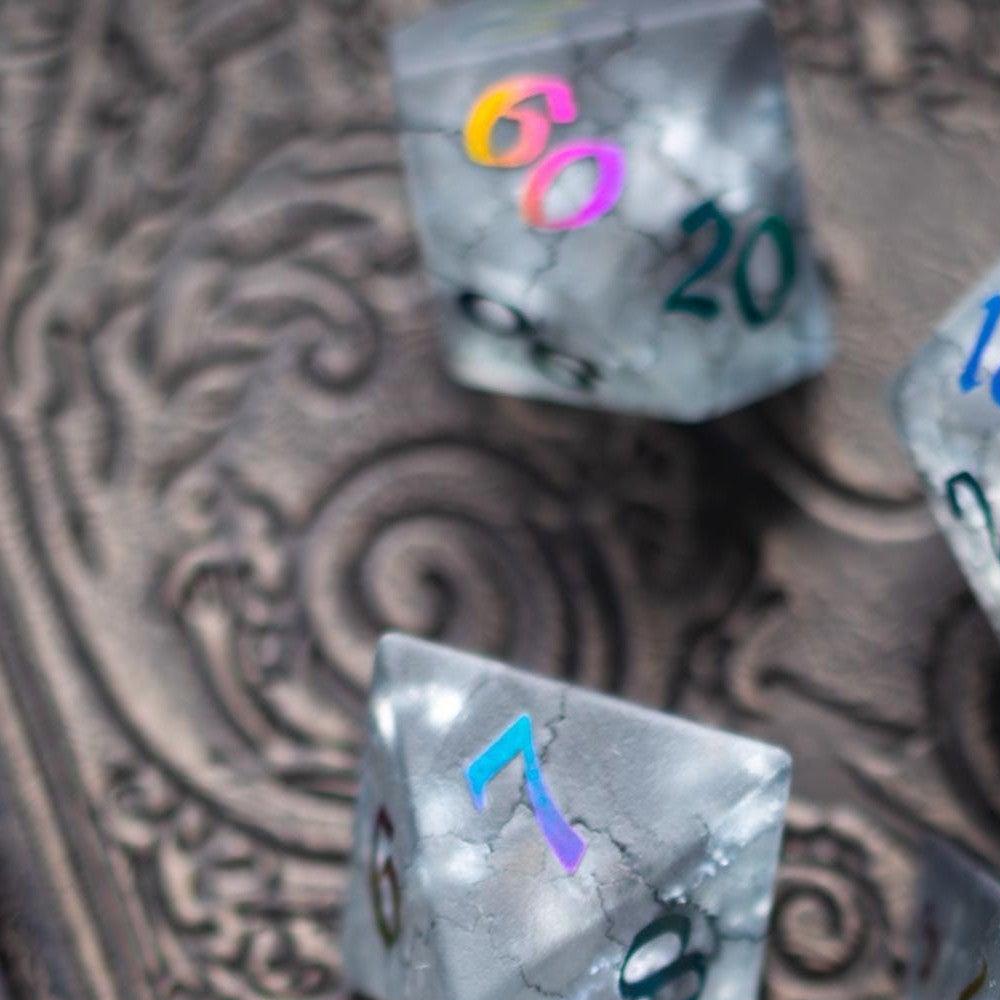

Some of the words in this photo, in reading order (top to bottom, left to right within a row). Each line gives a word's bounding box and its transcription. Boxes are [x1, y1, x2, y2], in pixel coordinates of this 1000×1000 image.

[463, 72, 626, 232] 60
[665, 200, 796, 331] 20
[465, 713, 586, 876] 7
